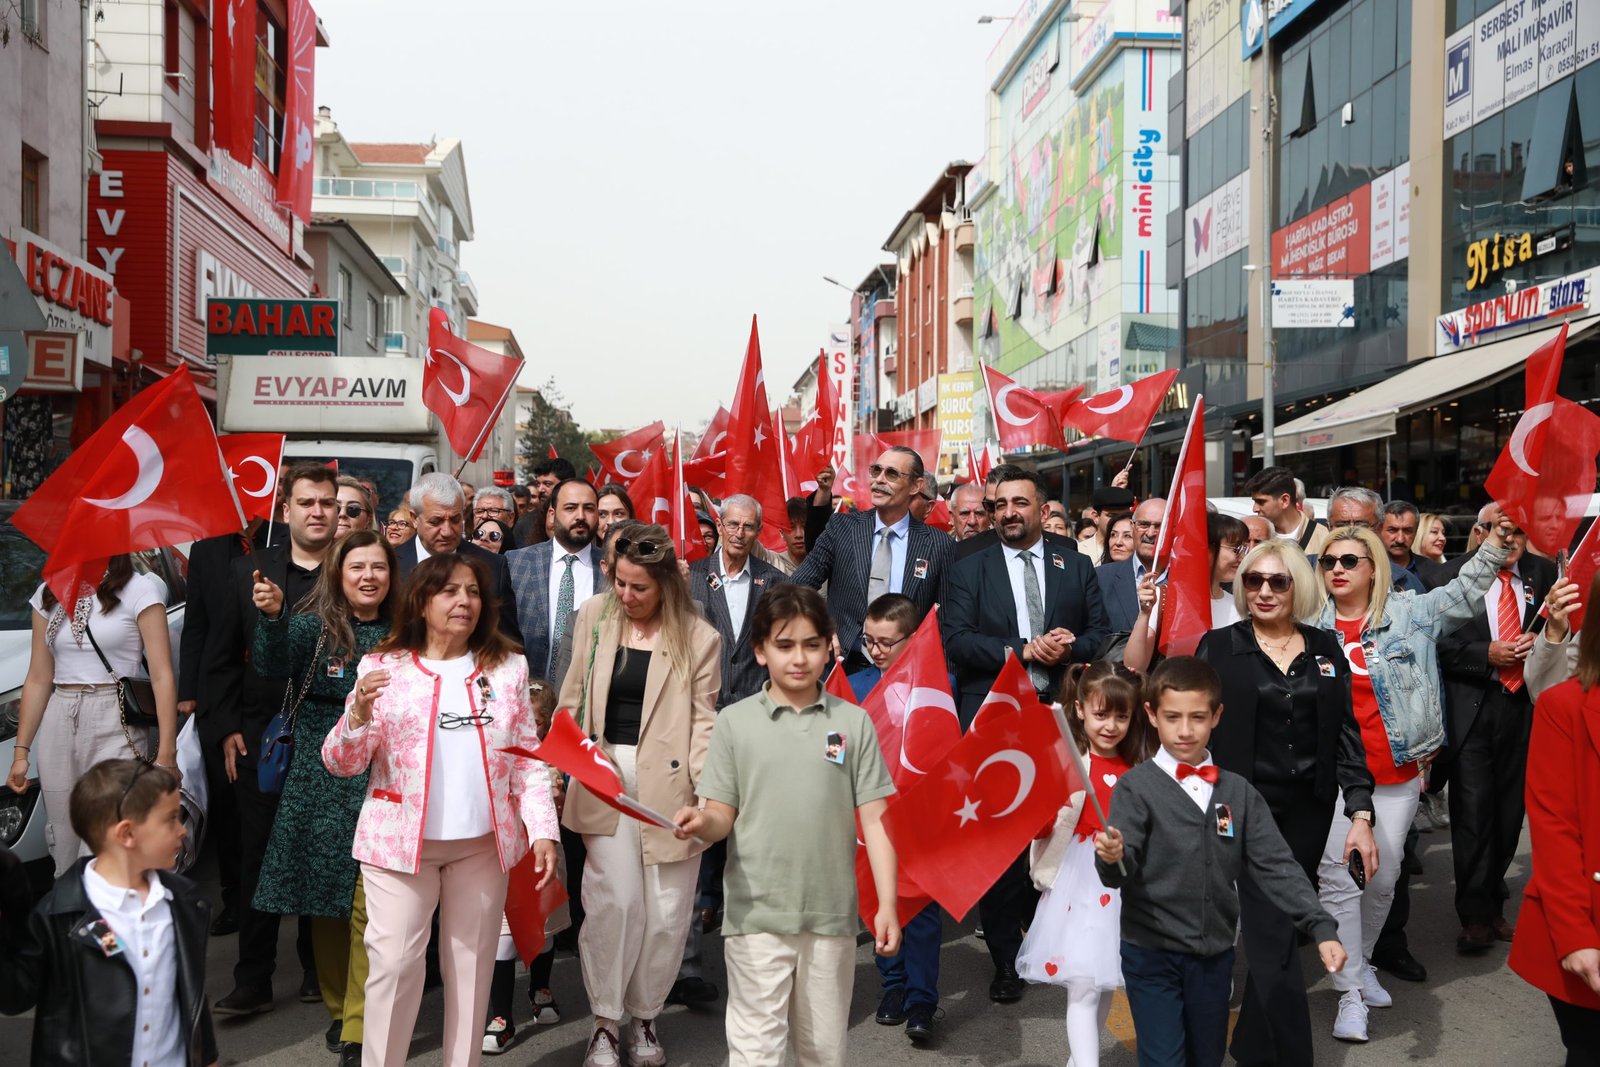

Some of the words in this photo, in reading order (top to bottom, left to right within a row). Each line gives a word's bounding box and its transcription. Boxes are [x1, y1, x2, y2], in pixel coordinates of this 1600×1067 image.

[1481, 0, 1526, 42] SERBEST
[1497, 28, 1521, 62] MALİ
[1523, 0, 1573, 47] MÜŞAVİR
[1505, 57, 1533, 82] Elmas
[1539, 29, 1573, 64] Karaçil
[1557, 54, 1574, 73] 0552
[1576, 47, 1588, 65] 621
[1132, 128, 1161, 237] minicity
[27, 241, 113, 327] ECZANE
[1465, 232, 1532, 291] Nisa
[1549, 279, 1586, 310] store
[208, 302, 336, 337] BAHAR
[34, 339, 66, 377] E
